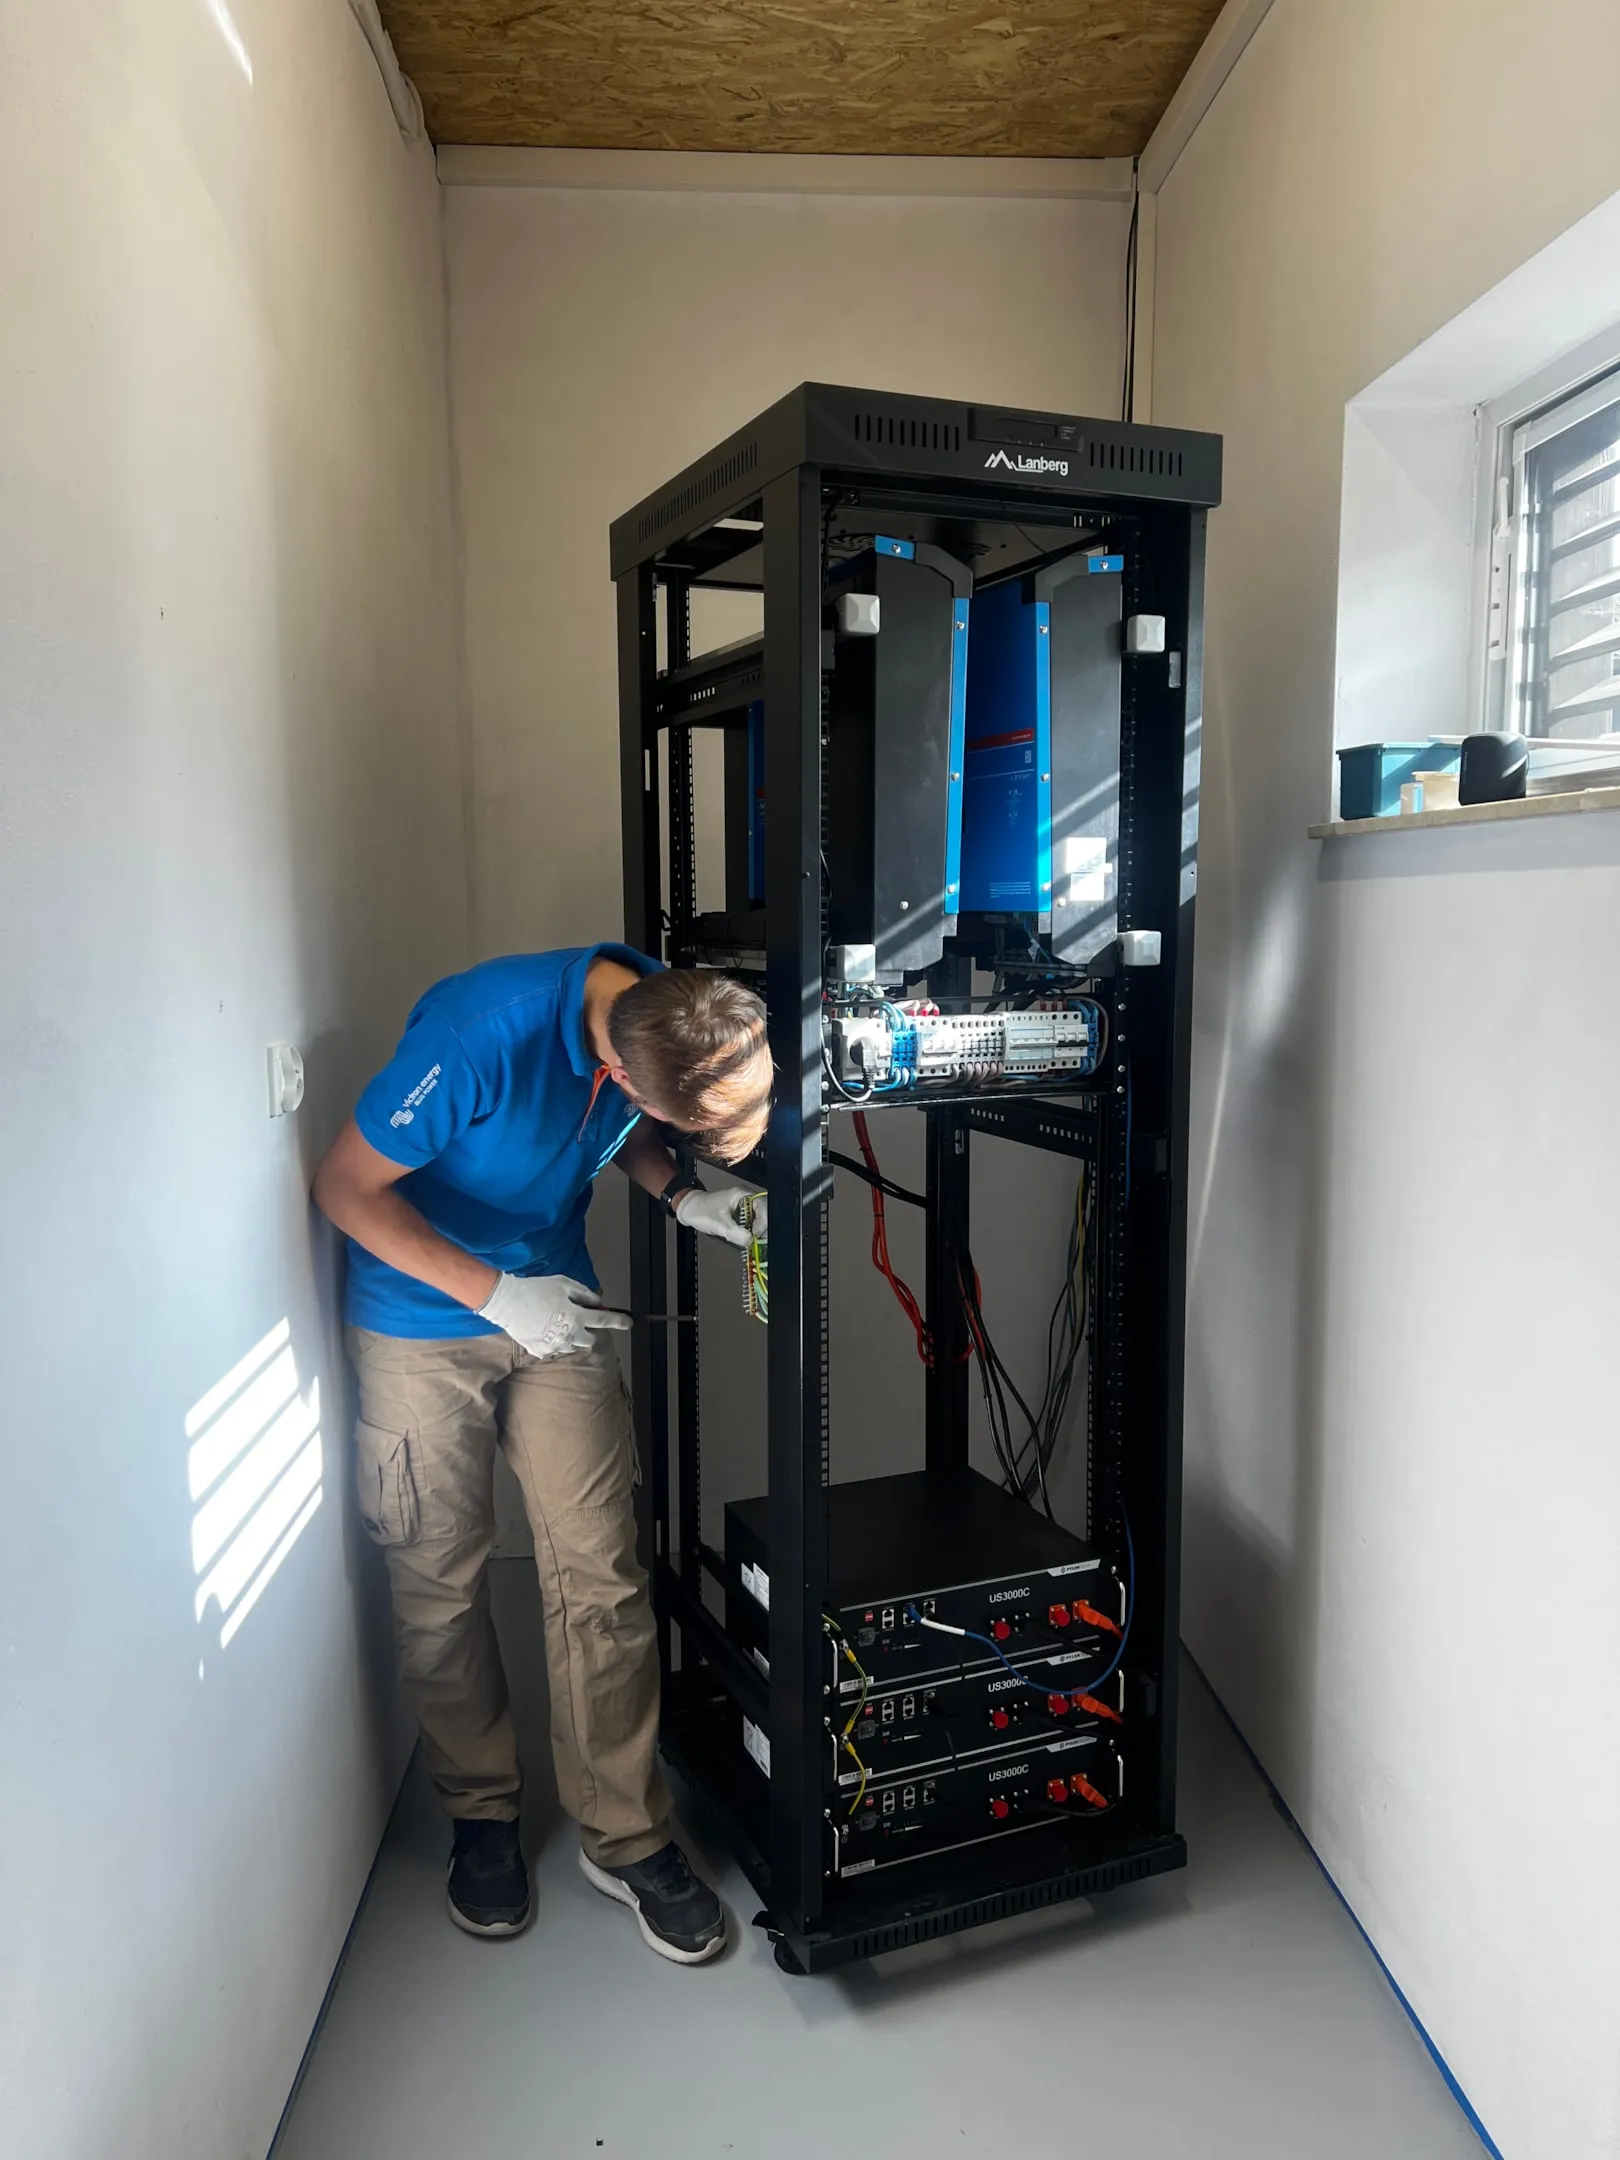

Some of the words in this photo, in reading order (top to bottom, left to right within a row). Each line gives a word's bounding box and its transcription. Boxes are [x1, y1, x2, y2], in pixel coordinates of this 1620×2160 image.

[1017, 454, 1069, 476] Lanberg
[420, 1063, 442, 1088] energy
[989, 1587, 1030, 1603] US3000C
[988, 1763, 1029, 1782] US3000C
